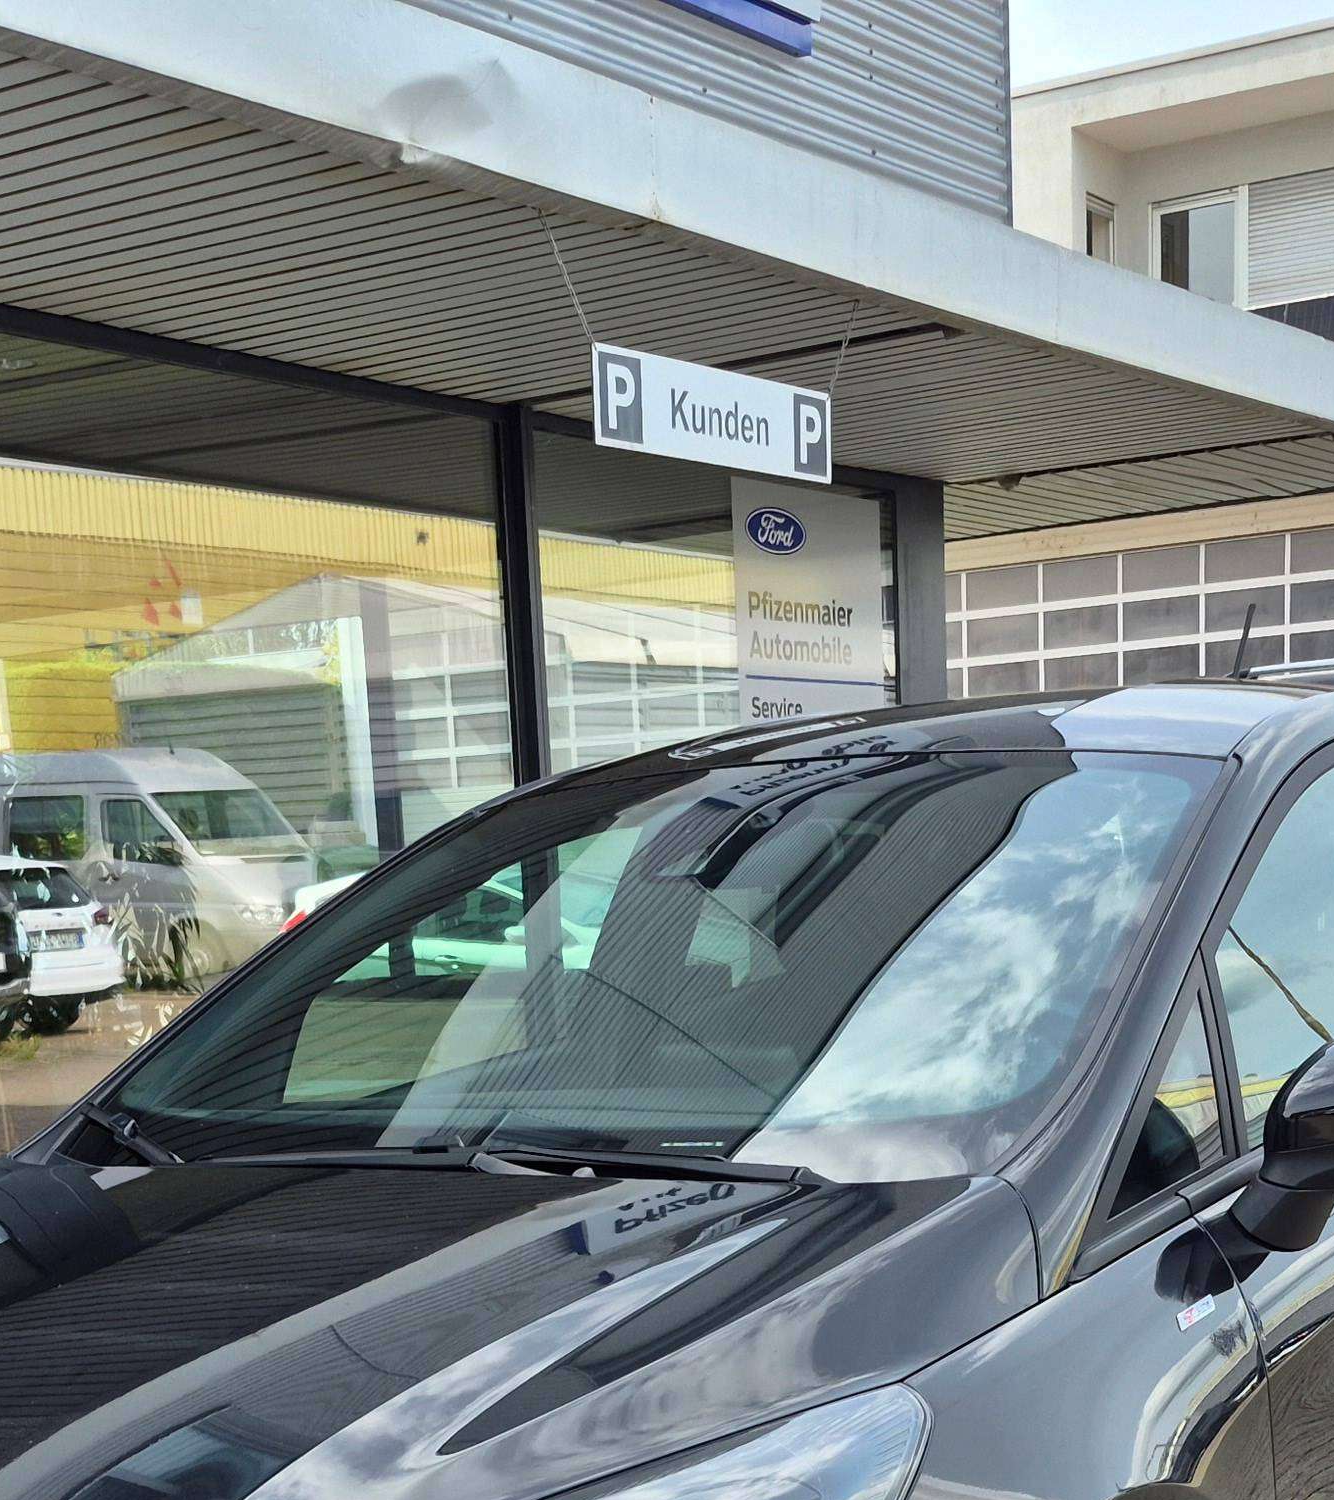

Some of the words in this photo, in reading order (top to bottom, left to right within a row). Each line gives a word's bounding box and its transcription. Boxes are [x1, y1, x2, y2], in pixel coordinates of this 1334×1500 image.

[606, 361, 636, 430] P
[670, 387, 770, 447] Kunden
[798, 402, 823, 465] P
[756, 511, 796, 549] Ford
[747, 590, 854, 628] Pfizenmaier
[749, 630, 853, 666] Automobile
[751, 696, 803, 718] Service
